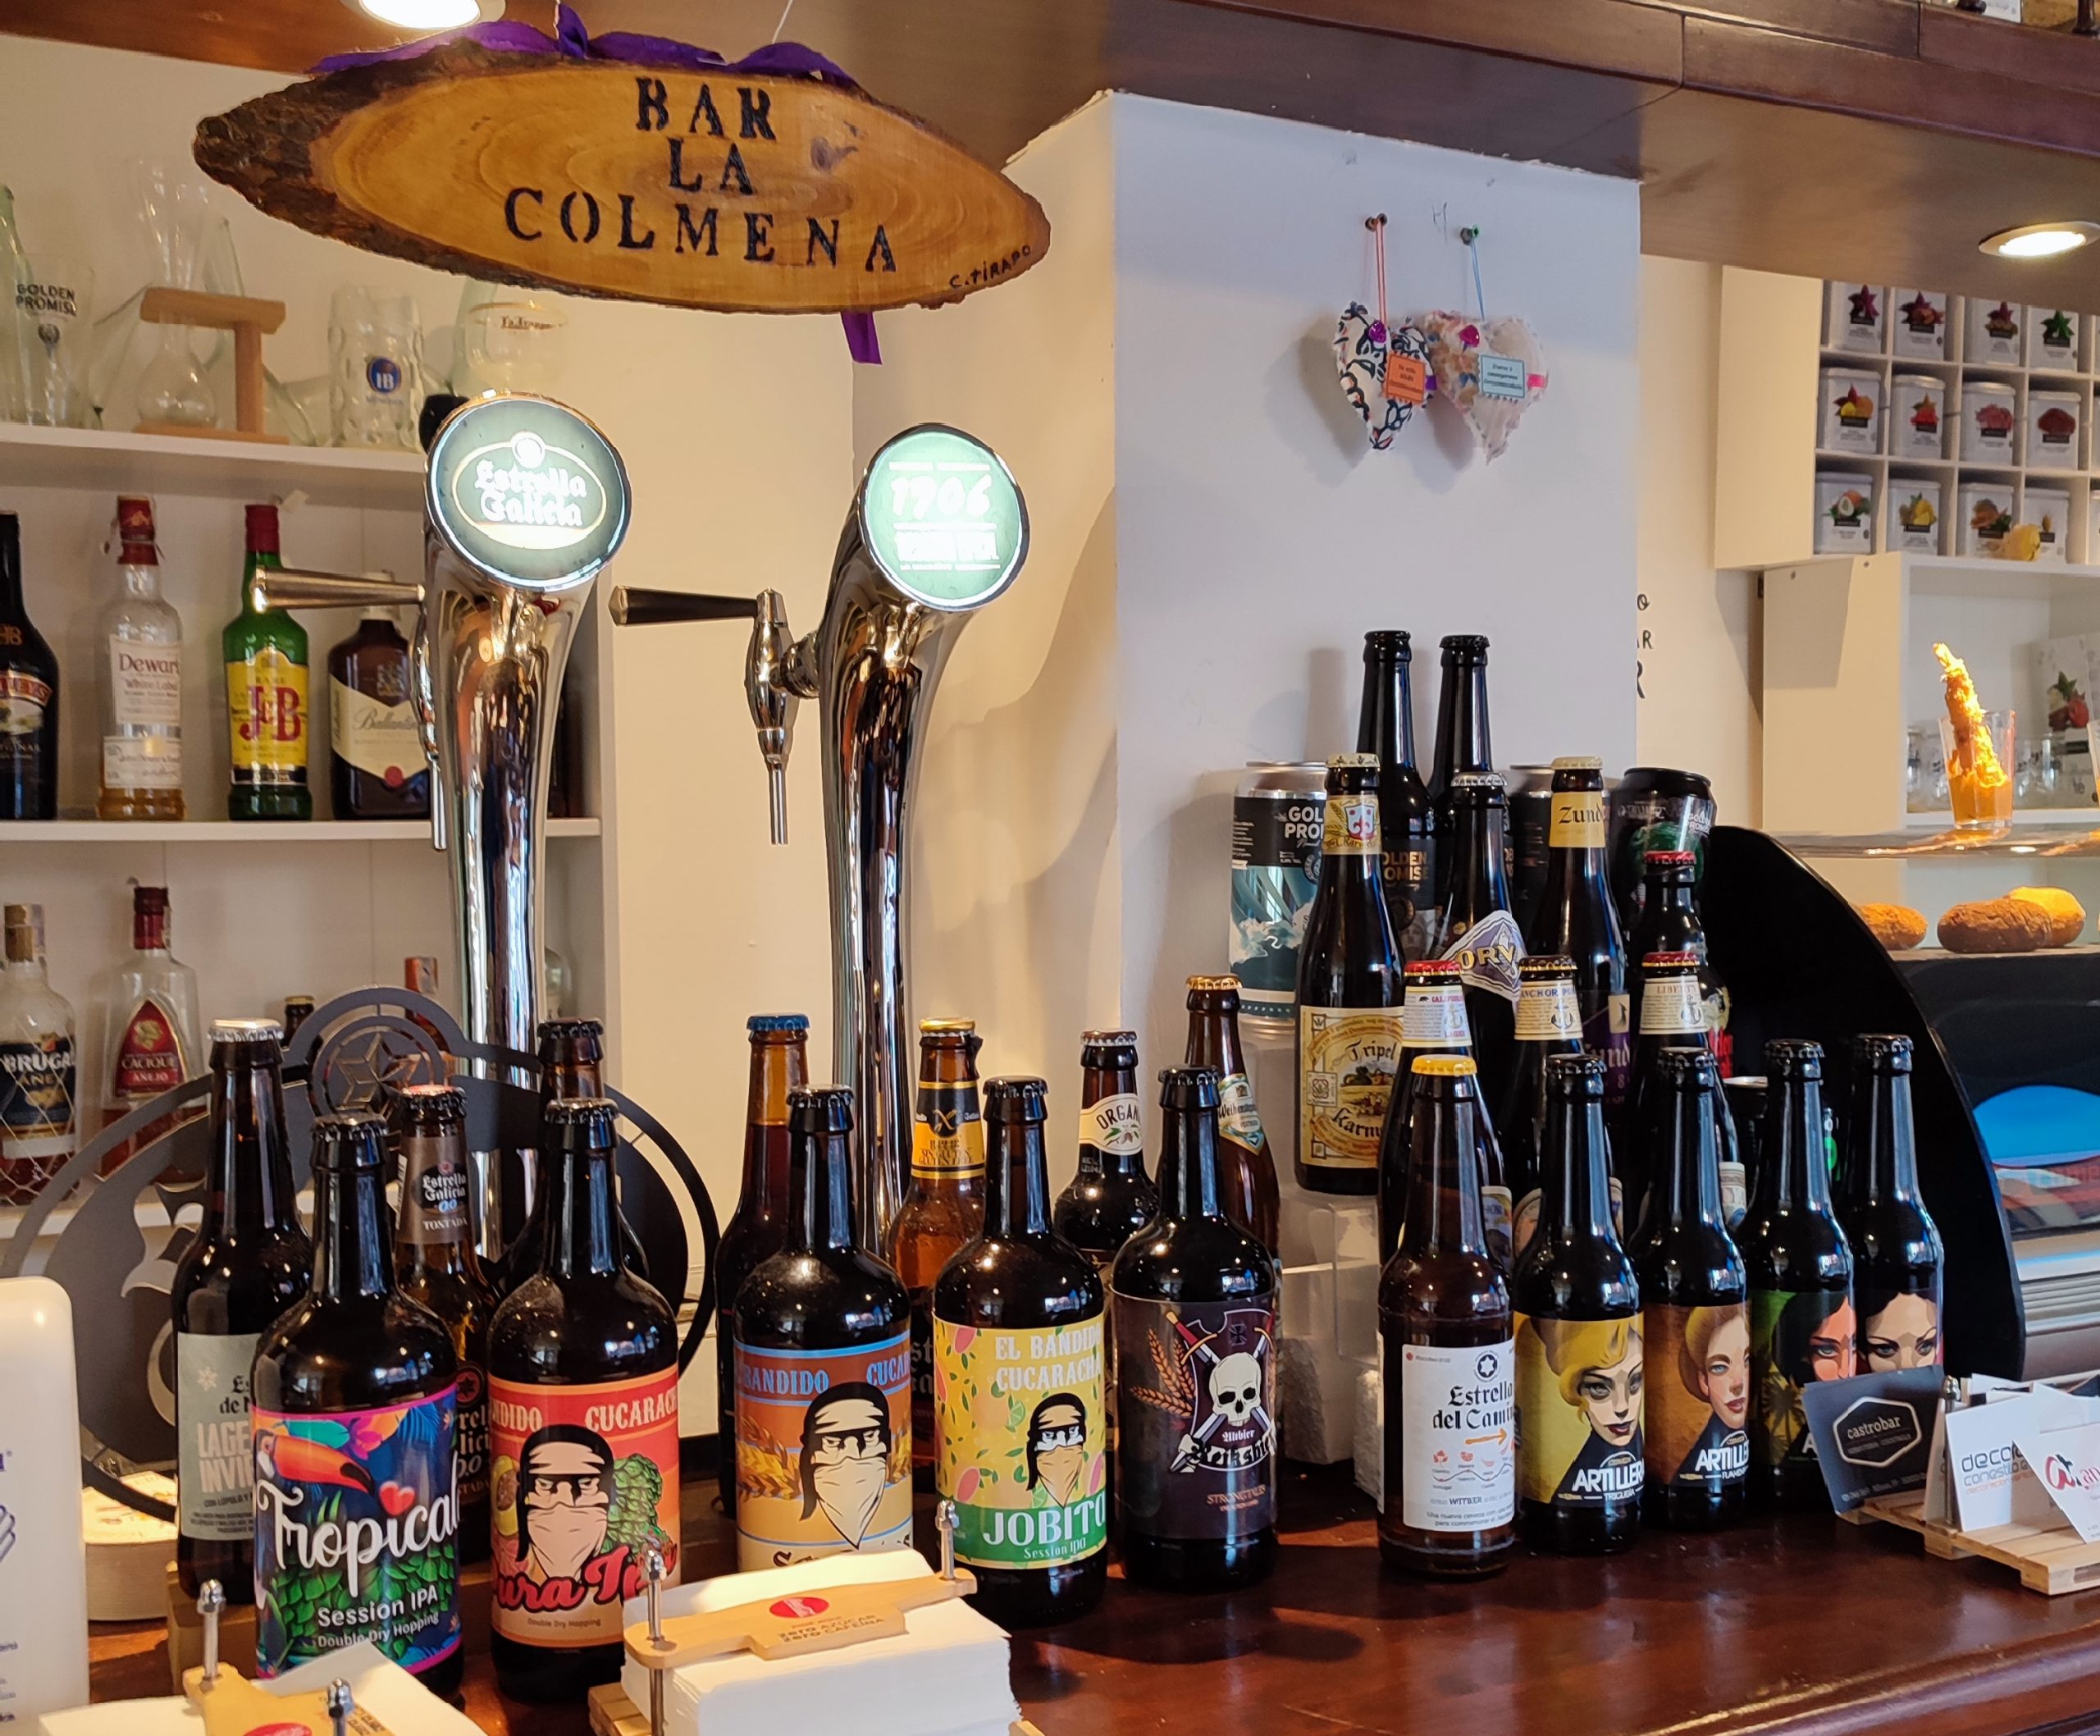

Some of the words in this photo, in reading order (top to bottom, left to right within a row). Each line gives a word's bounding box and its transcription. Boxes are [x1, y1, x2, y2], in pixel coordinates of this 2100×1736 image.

[635, 76, 778, 141] BAR
[666, 136, 756, 197] LA
[503, 185, 897, 274] COLMENA
[16, 283, 75, 302] GOLDEN
[890, 473, 993, 520] 1906
[1288, 806, 1327, 823] GOL
[1284, 823, 1325, 839] PRO
[995, 1336, 1020, 1360] EL
[1433, 1409, 1461, 1429] del
[1847, 1416, 1901, 1440] castrobar
[257, 1450, 460, 1597] Tropical
[1024, 1543, 1067, 1559] Session
[317, 1599, 404, 1627] Session
[411, 1584, 438, 1610] IPA
[369, 1629, 391, 1645] Dry
[393, 1612, 440, 1637] Hopping
[554, 1619, 566, 1629] Dry
[568, 1619, 601, 1629] Hopping
